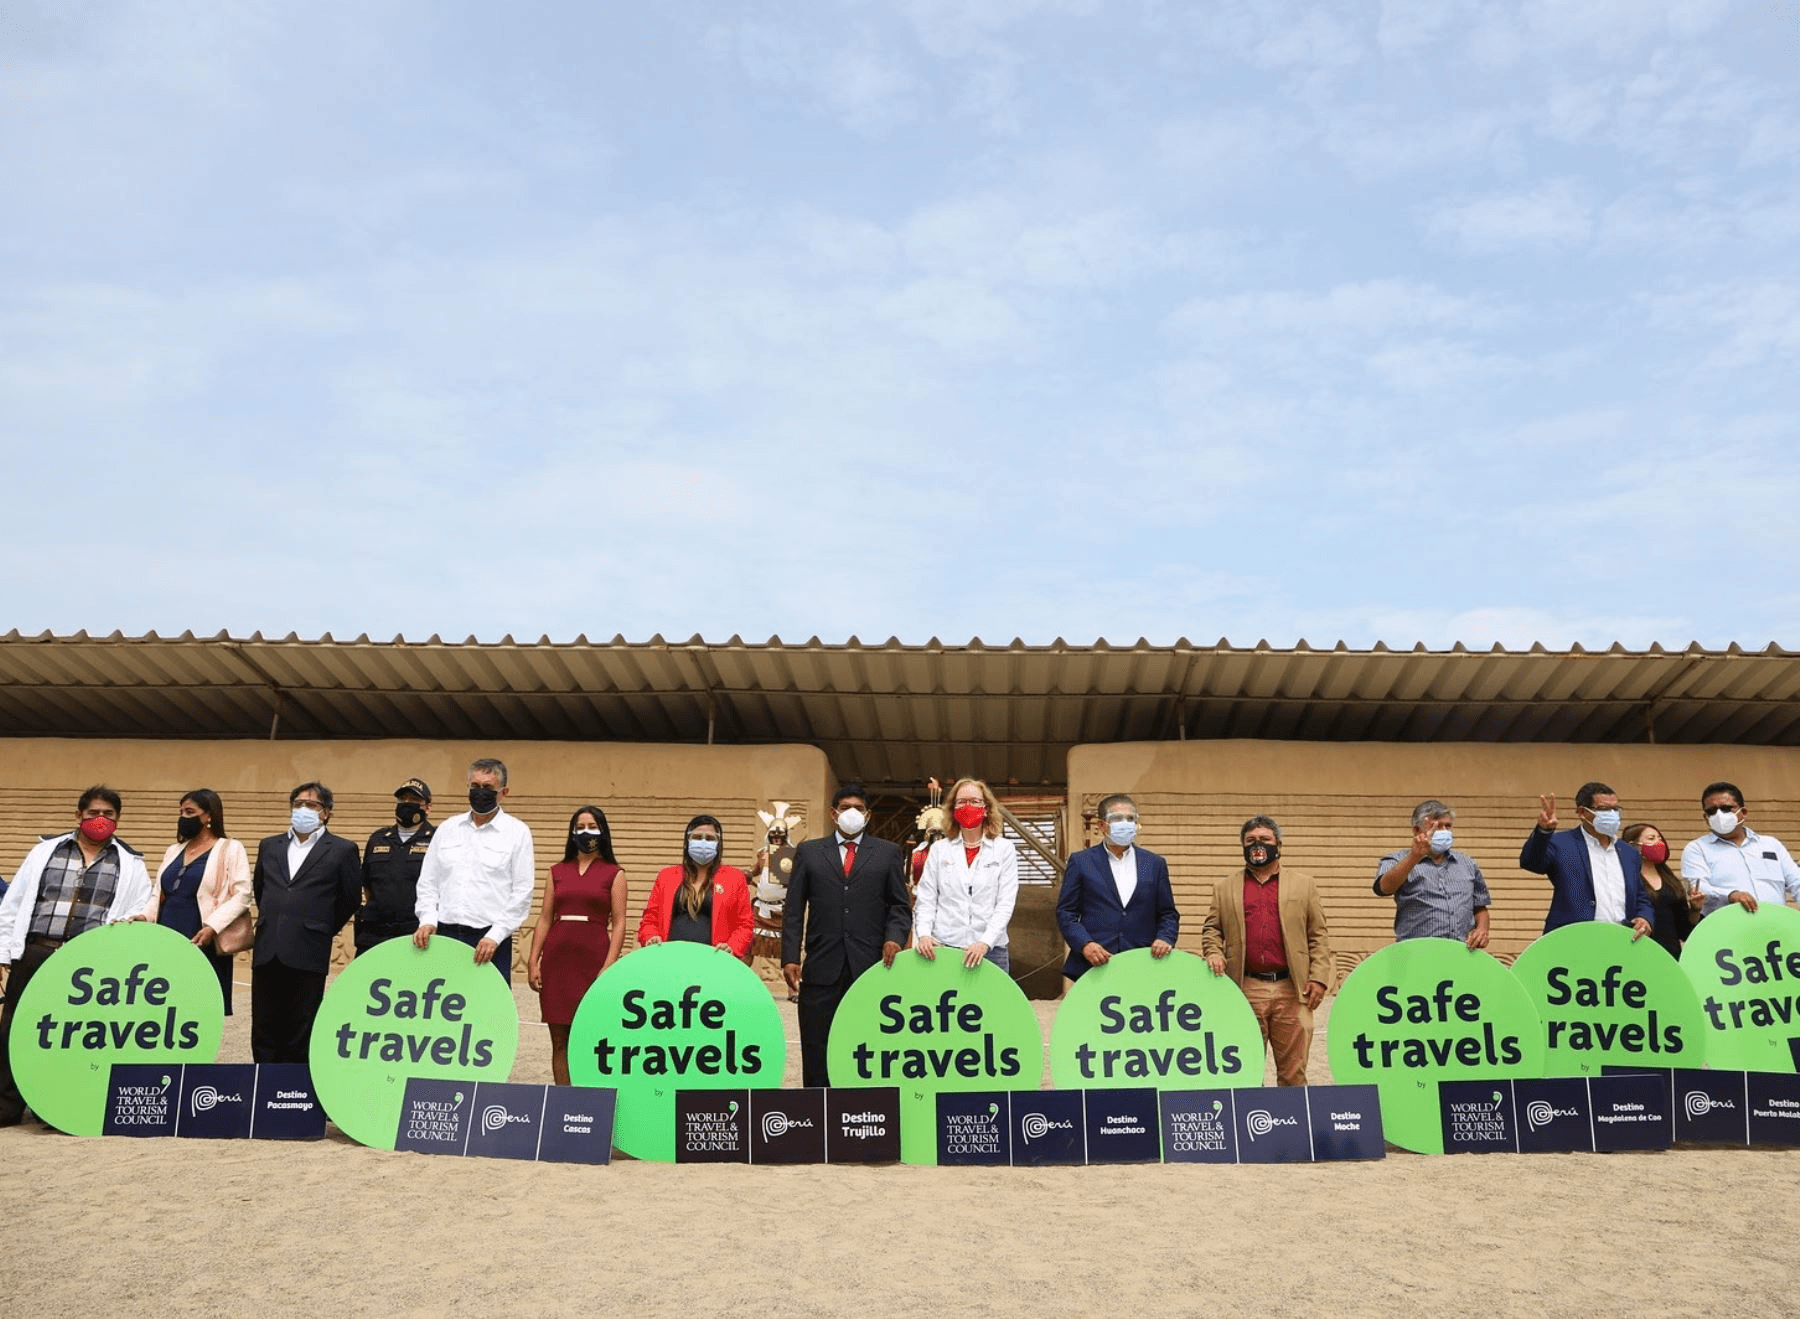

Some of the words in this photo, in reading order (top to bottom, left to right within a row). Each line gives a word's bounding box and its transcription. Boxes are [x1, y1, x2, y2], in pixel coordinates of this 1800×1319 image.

[68, 964, 169, 1005] Safe
[1547, 966, 1646, 1008] Safe
[367, 978, 466, 1021] Safe
[1377, 980, 1480, 1024] Safe
[622, 986, 725, 1029] Safe
[880, 990, 983, 1034] Safe
[1100, 990, 1202, 1034] Safe
[1704, 996, 1800, 1030] trav
[37, 1007, 198, 1049] travels
[1541, 1010, 1683, 1053] ravels
[336, 1023, 493, 1067] travels
[1353, 1022, 1521, 1068] travels
[594, 1030, 761, 1075] travels
[853, 1033, 1020, 1079] travels
[1075, 1031, 1242, 1078] travels
[119, 1087, 160, 1095] WORLD
[414, 1101, 453, 1111] WORLD
[1451, 1103, 1493, 1112] WORLD
[1613, 1103, 1644, 1111] Destino
[1769, 1099, 1799, 1107] Destino
[116, 1106, 167, 1114] TOURISM
[115, 1116, 166, 1124] COUNCIL
[564, 1114, 593, 1122] Destino
[687, 1113, 728, 1121] WORLD
[842, 1112, 885, 1123] Destino
[947, 1115, 989, 1124] WORLD
[1171, 1113, 1213, 1122] WORLD
[1331, 1112, 1361, 1120] Destino
[409, 1120, 458, 1131] TOURISM
[1452, 1122, 1504, 1132] TOURISM
[408, 1129, 457, 1141] COUNCIL
[686, 1132, 738, 1141] TOURISM
[842, 1126, 885, 1139] Trujillo
[1172, 1132, 1224, 1142] TOURISM
[1454, 1131, 1506, 1140] COUNCIL
[947, 1134, 998, 1143] TOURISM
[687, 1142, 739, 1150] COUNCIL
[948, 1144, 1000, 1153] COUNCIL
[1174, 1141, 1226, 1150] COUNCIL
